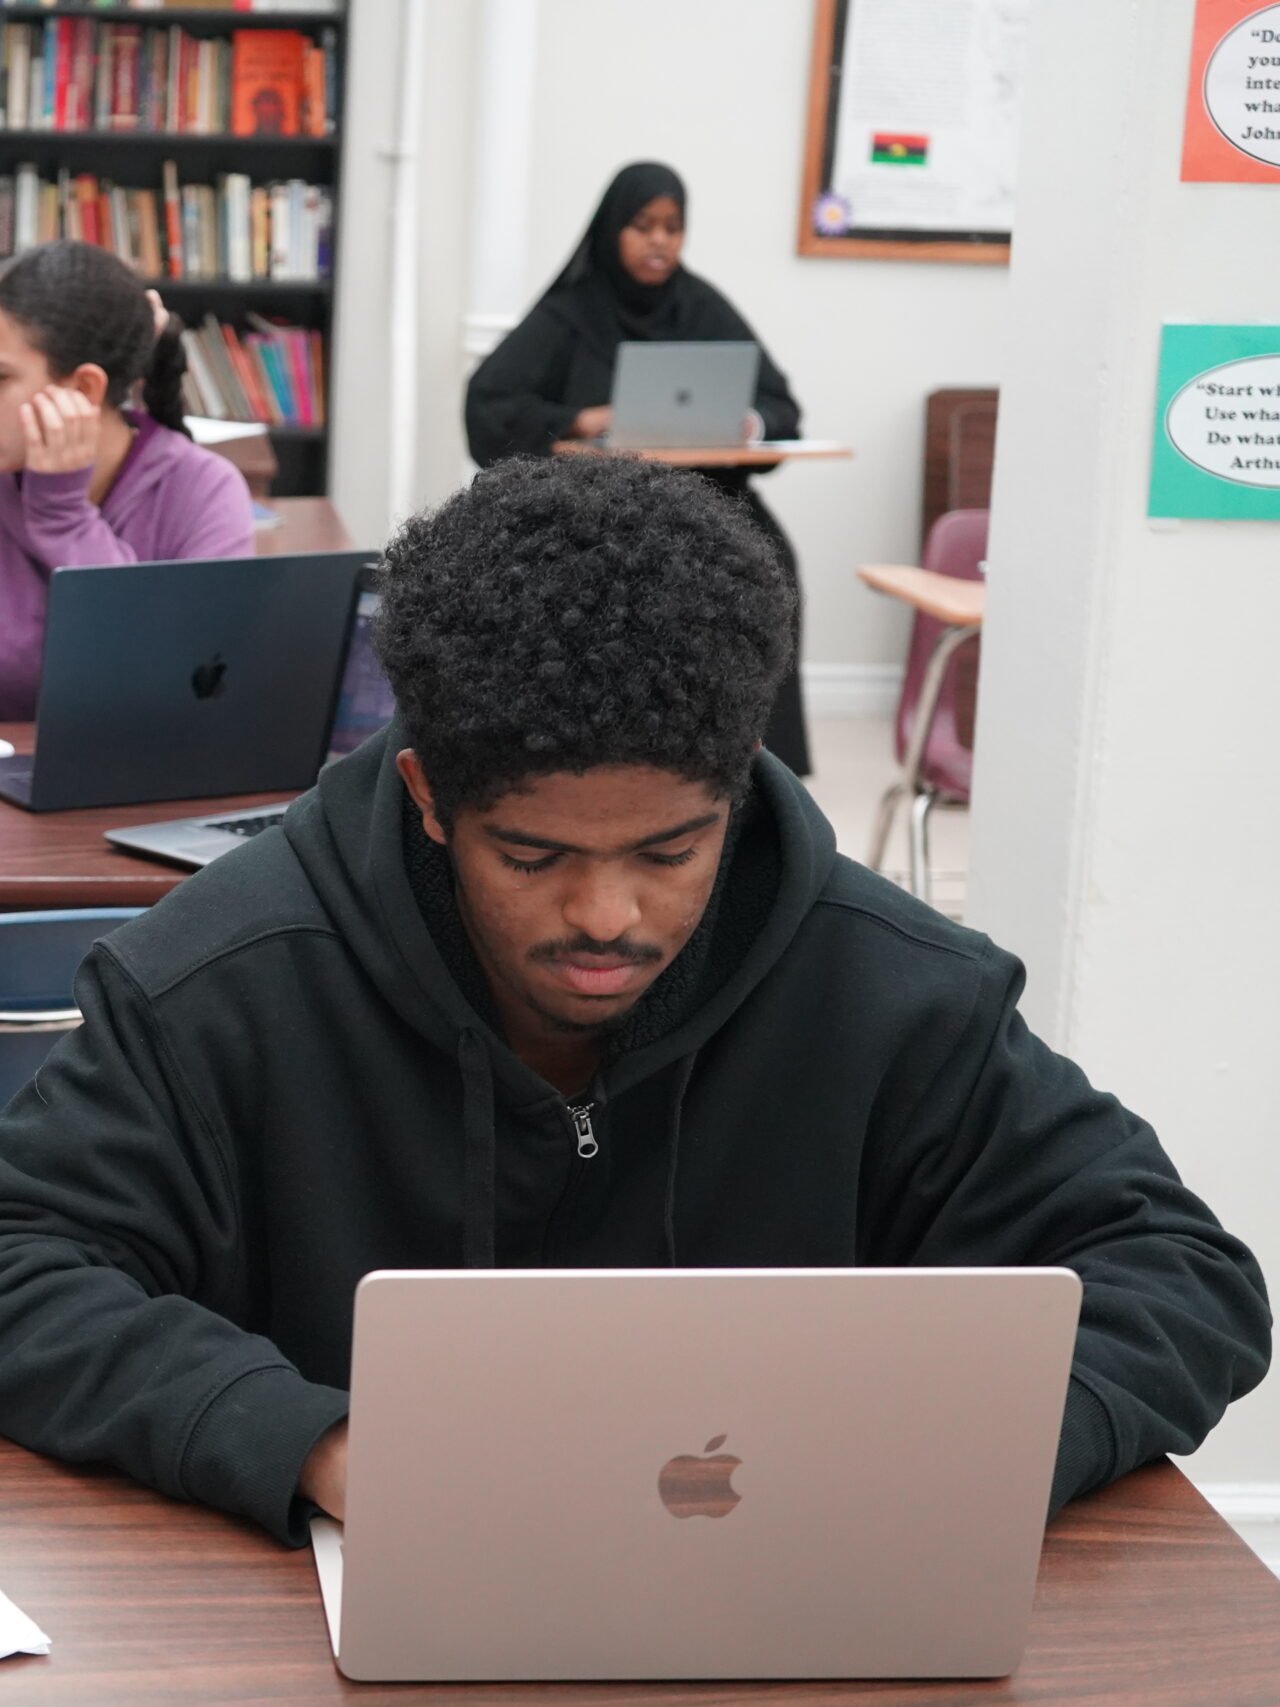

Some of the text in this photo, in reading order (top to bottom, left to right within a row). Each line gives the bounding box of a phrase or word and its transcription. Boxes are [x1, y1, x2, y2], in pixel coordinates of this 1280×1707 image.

[1247, 55, 1280, 69] you
[1196, 383, 1253, 397] “Start
[1205, 406, 1280, 421] Use wha
[1207, 431, 1231, 444] Do
